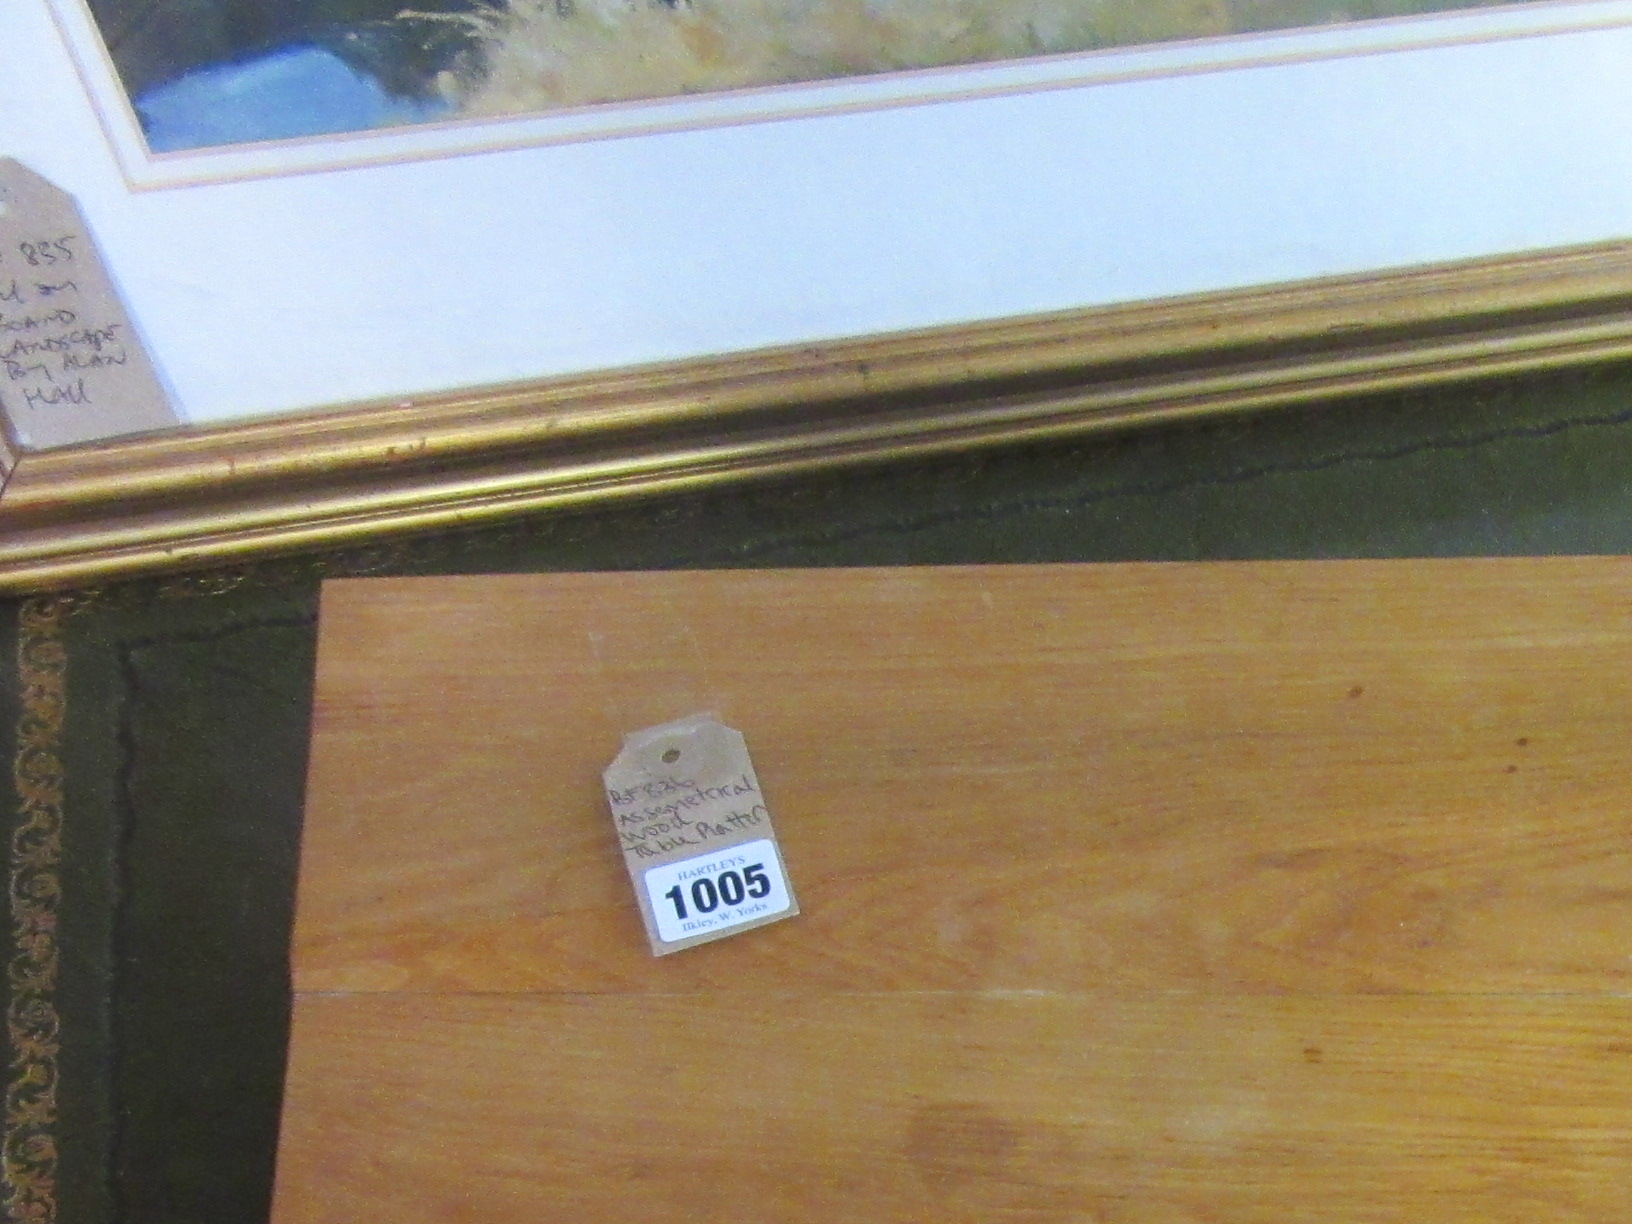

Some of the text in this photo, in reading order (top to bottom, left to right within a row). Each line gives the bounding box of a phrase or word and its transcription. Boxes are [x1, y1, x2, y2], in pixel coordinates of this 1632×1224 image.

[677, 855, 746, 881] HARTLEYS
[664, 862, 771, 920] 1005
[737, 902, 768, 917] Yorks
